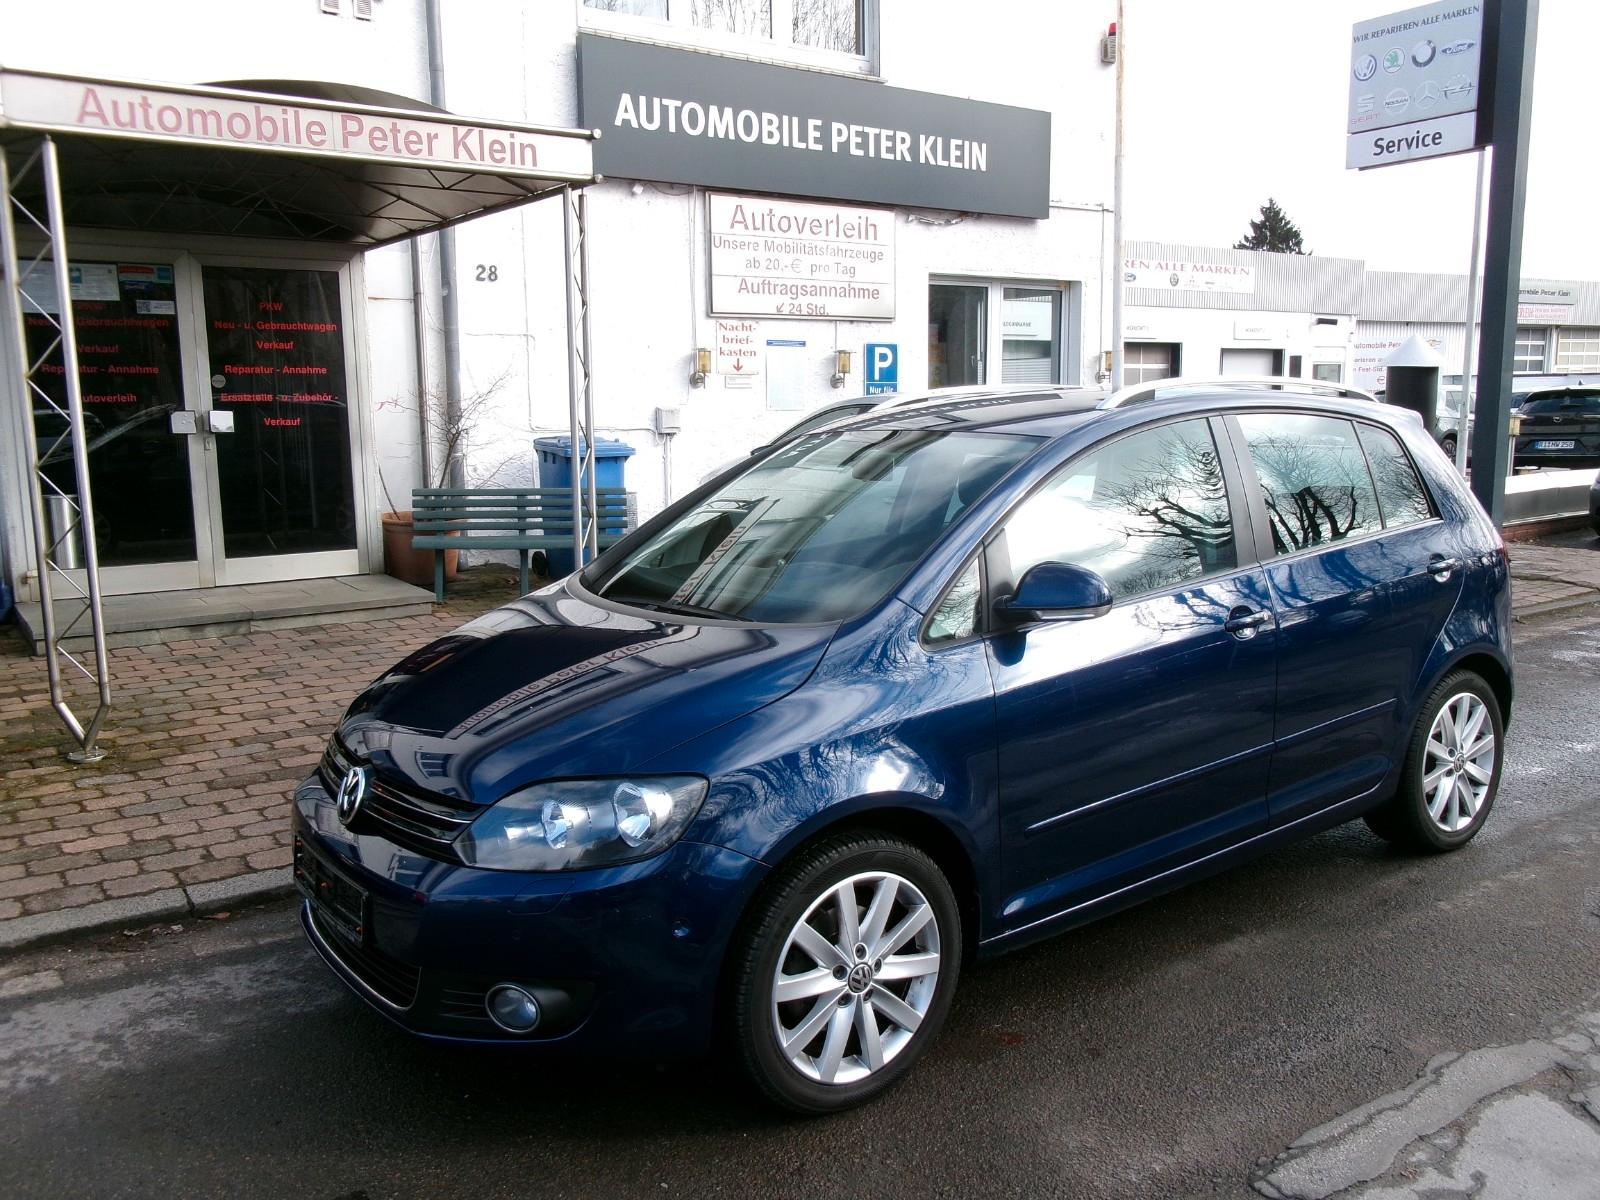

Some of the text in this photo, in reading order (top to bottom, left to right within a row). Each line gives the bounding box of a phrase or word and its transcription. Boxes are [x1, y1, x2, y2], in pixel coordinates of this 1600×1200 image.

[1353, 5, 1480, 43] WIR REPARIEREN ALLE MARKEN
[77, 87, 538, 168] Automobile Peter Klein
[614, 92, 988, 172] AUTOMOBILE PETER KLEIN
[1373, 130, 1443, 156] Service
[729, 204, 878, 241] Autoverleih
[712, 235, 884, 263] Unsere Mobilitätsfahrzeuge
[475, 264, 498, 282] 28
[745, 258, 761, 269] ab
[810, 263, 830, 276] pro
[834, 262, 856, 277] Tag
[1124, 259, 1250, 276] REN ALLE MARKEN
[738, 277, 880, 300] Auftragsannahme
[259, 302, 283, 311] PKW
[788, 303, 829, 316] 24 Std.
[214, 321, 235, 329] Neu
[256, 321, 337, 332] Gebrauchtwagen
[719, 322, 757, 332] Nacht-
[256, 341, 294, 349] Verkauf
[722, 335, 753, 345] brief-
[719, 347, 757, 357] kasten
[107, 364, 160, 374] Annahme
[874, 346, 893, 381] P
[224, 365, 274, 375] Reparatur
[282, 365, 327, 374] Annahme
[869, 385, 882, 394] Nur
[83, 394, 137, 403] utoverleih
[293, 393, 332, 401] Zubehör
[263, 417, 301, 426] Verkauf
